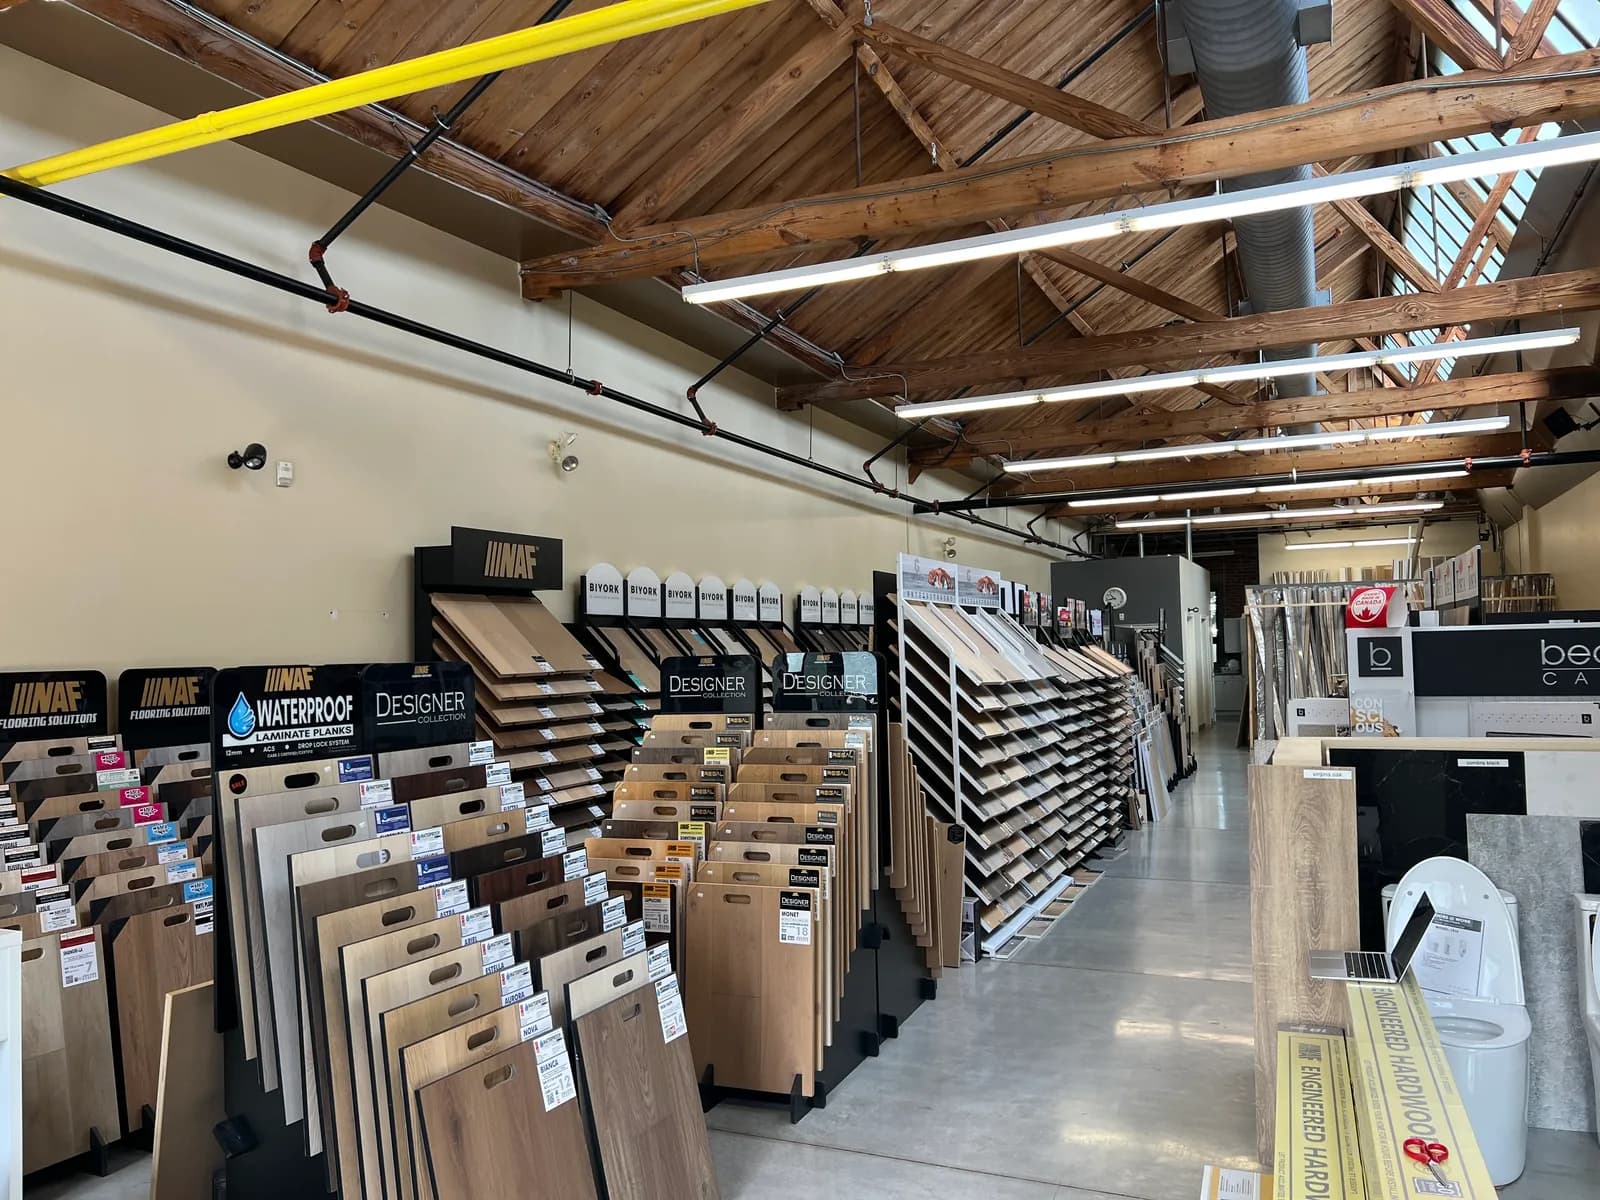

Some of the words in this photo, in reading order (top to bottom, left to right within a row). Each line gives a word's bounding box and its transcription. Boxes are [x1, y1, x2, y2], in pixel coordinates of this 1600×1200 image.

[497, 542, 537, 580] NAF
[589, 583, 620, 594] BIYORK
[630, 585, 658, 596] BIYORK
[667, 590, 693, 599] BIYORK
[701, 592, 724, 601] BIYORK
[735, 594, 754, 603] BIYORK
[761, 596, 779, 605] BIYORK
[278, 667, 314, 690] NAF
[669, 675, 745, 692] DESIGNER
[783, 672, 866, 690] DESIGNER
[157, 676, 200, 706] NAF
[31, 681, 82, 714] NAF
[1355, 697, 1383, 708] CON
[257, 694, 353, 727] WATERPROOF
[376, 692, 465, 717] DESIGNER
[48, 713, 98, 726] SOLUTIONS
[130, 708, 171, 720] FLOORING
[417, 712, 466, 724] COLLECTION
[1355, 709, 1383, 722] SCI
[256, 730, 311, 742] LAMINATE
[313, 725, 352, 737] PLANKS
[1355, 722, 1384, 733] OUS
[329, 739, 350, 747] SYSTEM
[791, 874, 817, 882] DESIGNER
[782, 896, 809, 905] DESIGNER
[658, 914, 669, 924] 18
[796, 927, 808, 936] 18
[485, 963, 504, 974] ESTELLA
[505, 992, 525, 1004] AURORA
[523, 1025, 538, 1036] NOVA
[540, 1060, 559, 1073] BIANCA
[1301, 1065, 1326, 1143] ENGINEERED
[1389, 1054, 1439, 1143] HARDWOO
